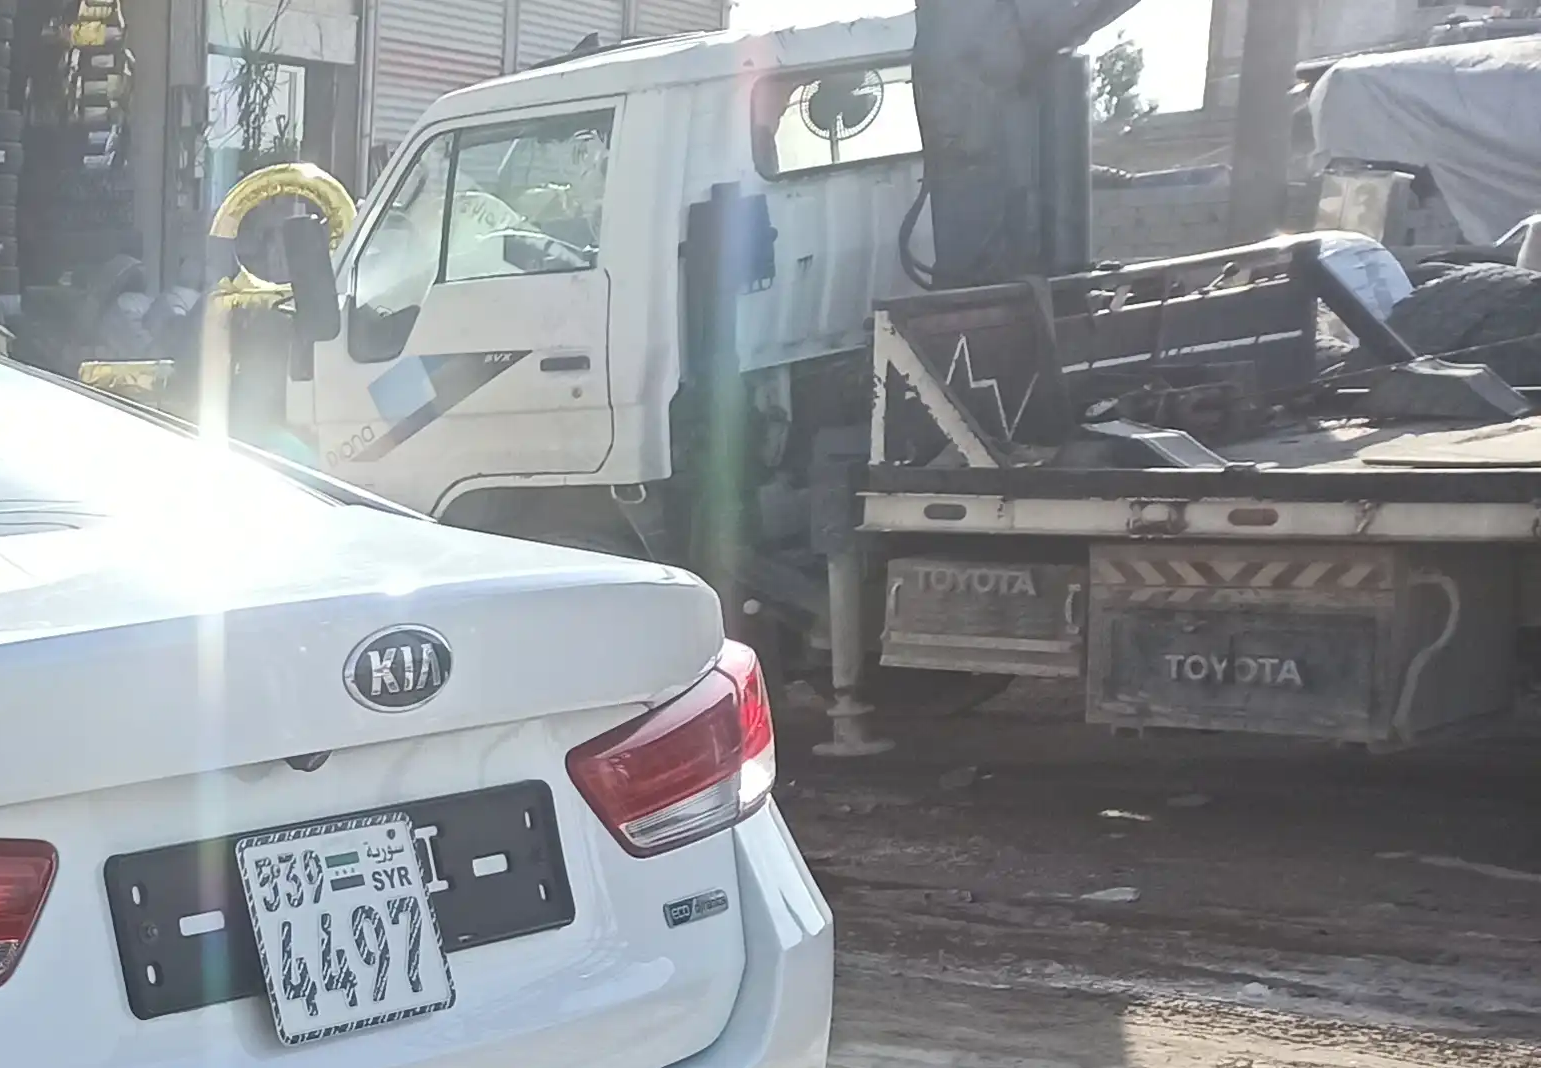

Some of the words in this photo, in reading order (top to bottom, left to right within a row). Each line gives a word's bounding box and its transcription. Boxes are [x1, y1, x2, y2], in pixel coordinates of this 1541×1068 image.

[913, 566, 1036, 596] TOYOTA
[367, 642, 442, 696] KIA
[1164, 654, 1303, 686] TOYOTA
[367, 841, 405, 864] سورية
[371, 866, 413, 891] SYR
[281, 896, 423, 1017] 4497
